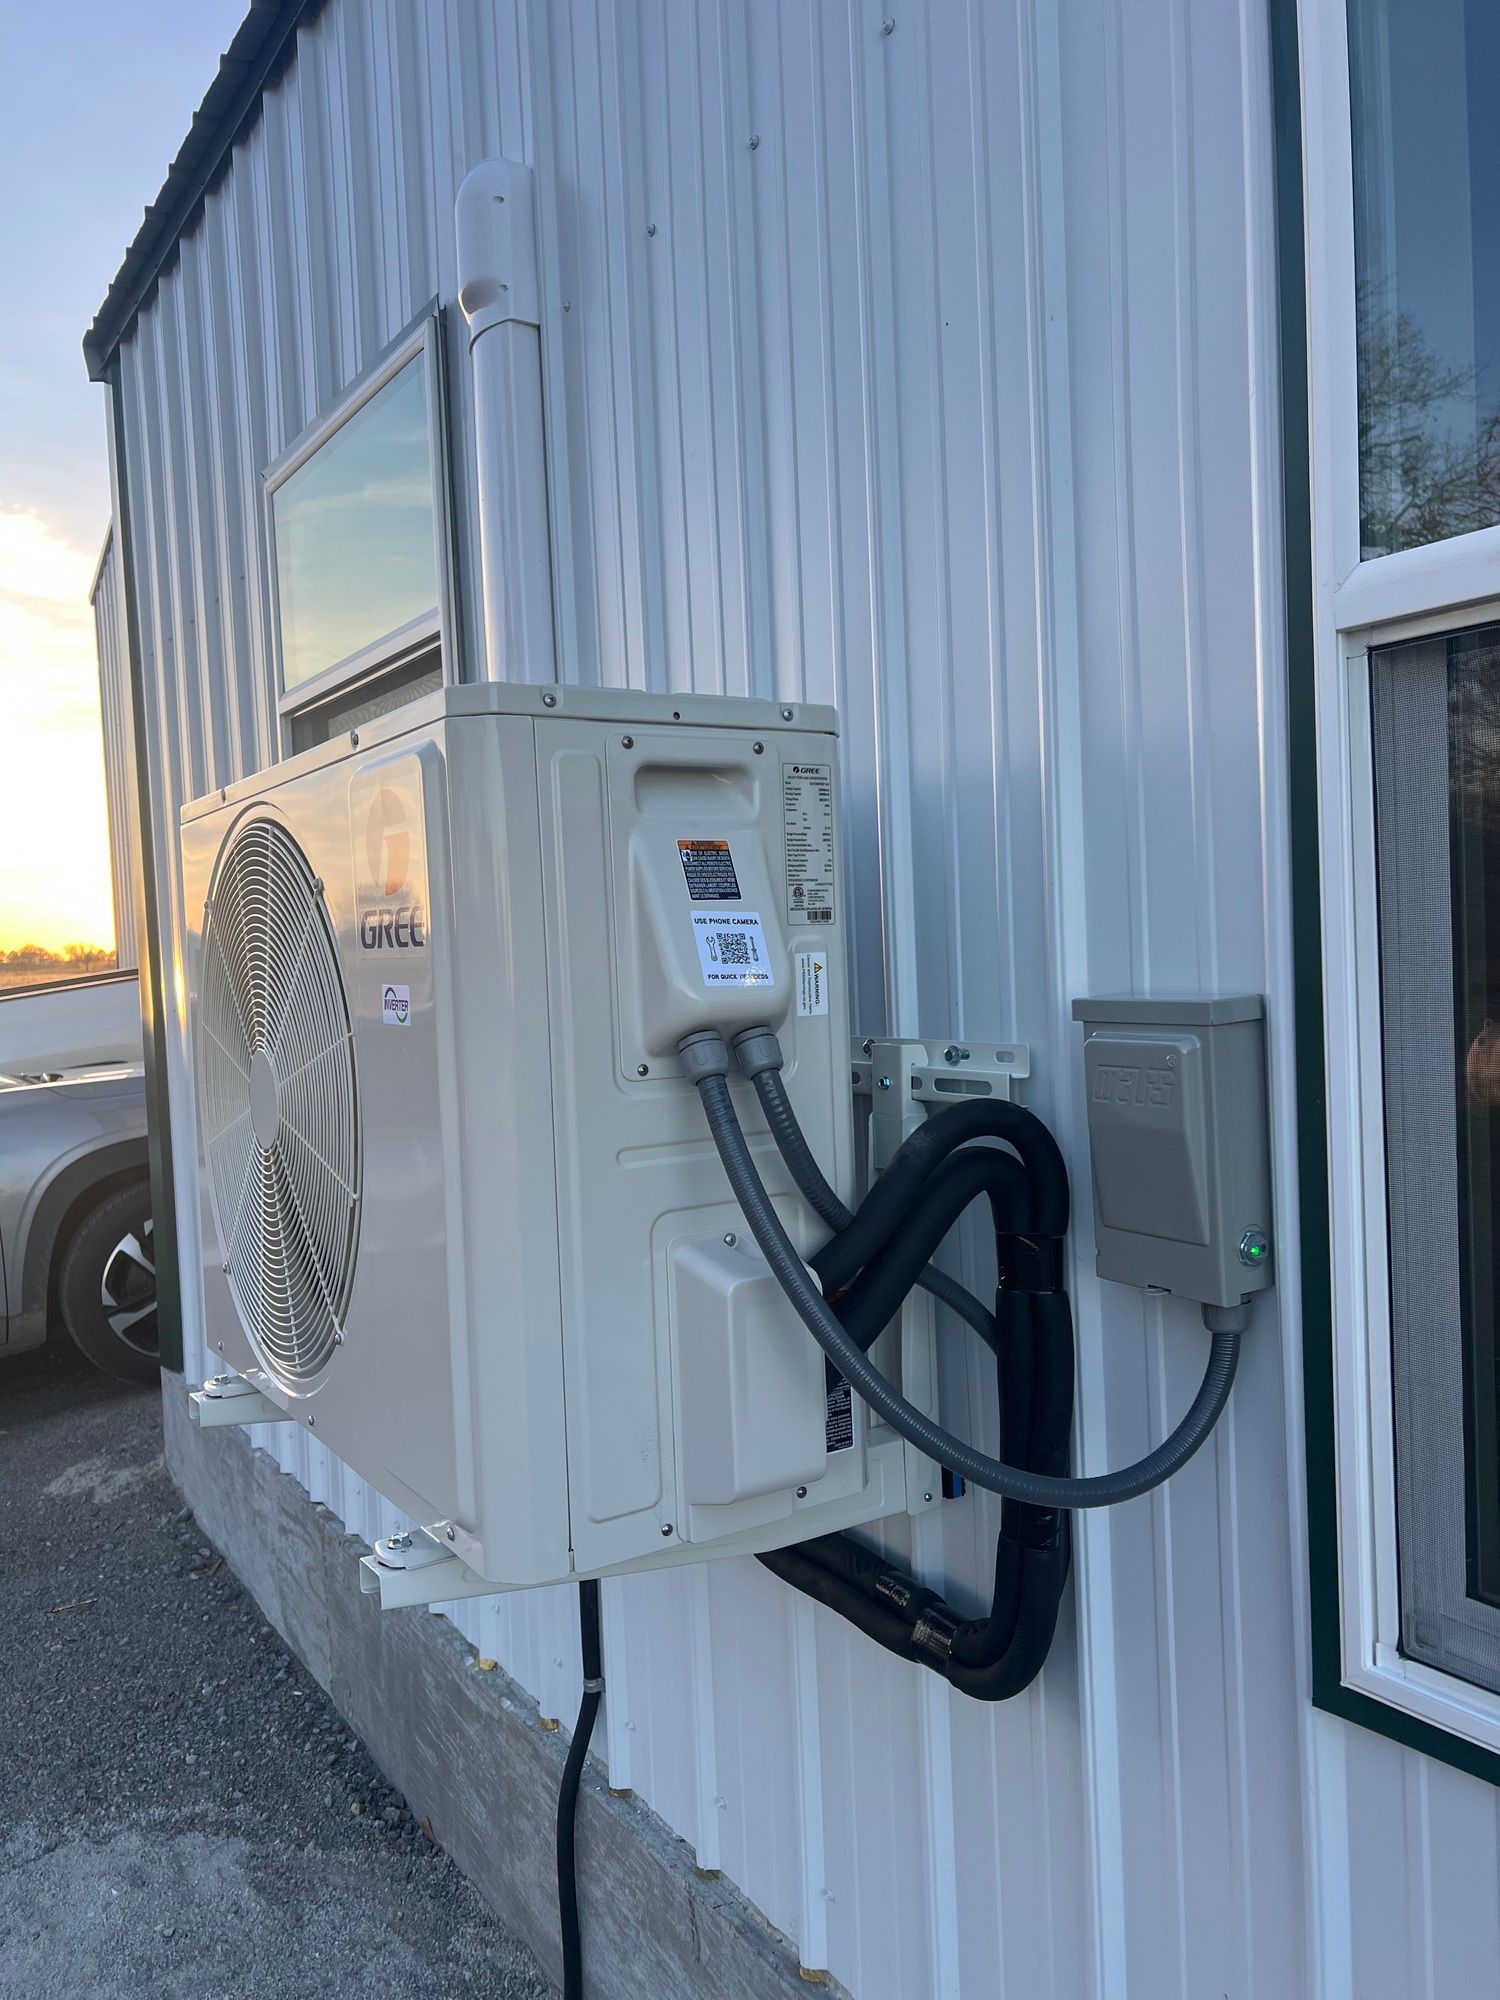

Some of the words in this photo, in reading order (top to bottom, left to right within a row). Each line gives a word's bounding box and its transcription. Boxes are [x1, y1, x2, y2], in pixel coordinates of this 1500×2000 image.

[800, 767, 821, 775] GREE
[361, 906, 424, 949] GREE
[384, 998, 409, 1012] INVERTER
